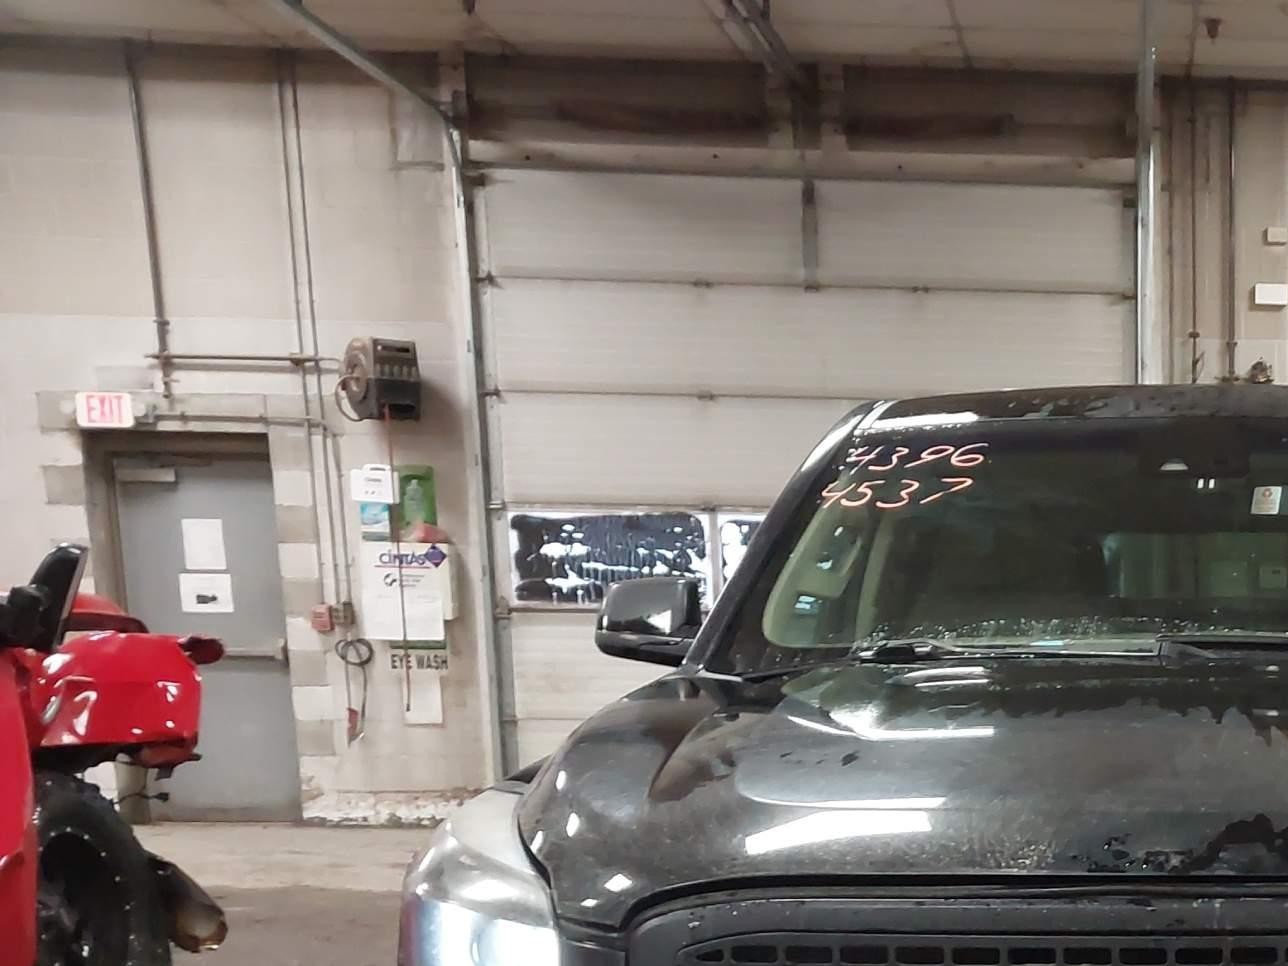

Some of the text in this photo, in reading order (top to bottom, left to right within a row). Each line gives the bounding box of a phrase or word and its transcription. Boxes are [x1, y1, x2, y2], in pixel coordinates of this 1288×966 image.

[86, 394, 123, 424] EXIT
[846, 443, 990, 475] 4396
[822, 476, 974, 508] 4537
[391, 654, 448, 670] EYE WASH
